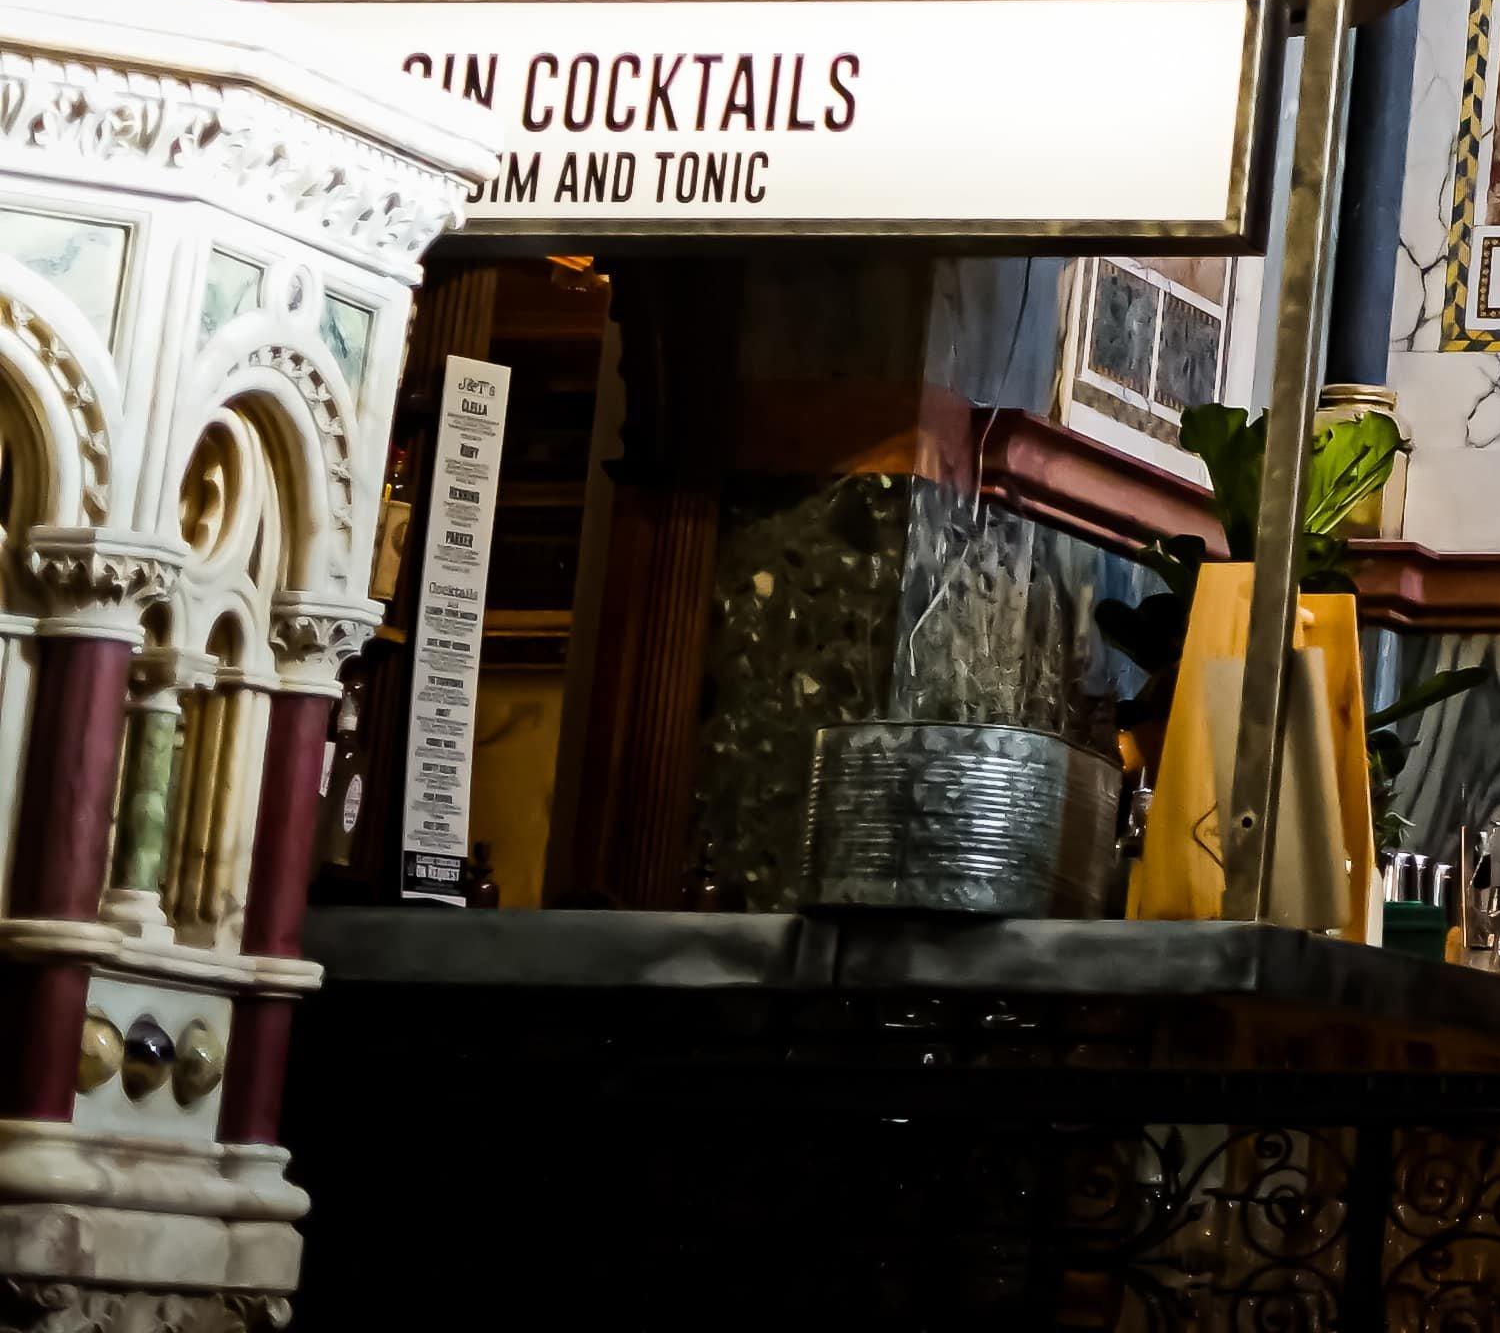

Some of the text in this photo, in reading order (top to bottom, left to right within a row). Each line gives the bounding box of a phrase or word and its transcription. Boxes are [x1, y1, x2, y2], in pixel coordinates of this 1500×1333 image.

[522, 51, 861, 134] COCKTAILS
[553, 151, 637, 204] AND
[655, 151, 770, 204] TONIC
